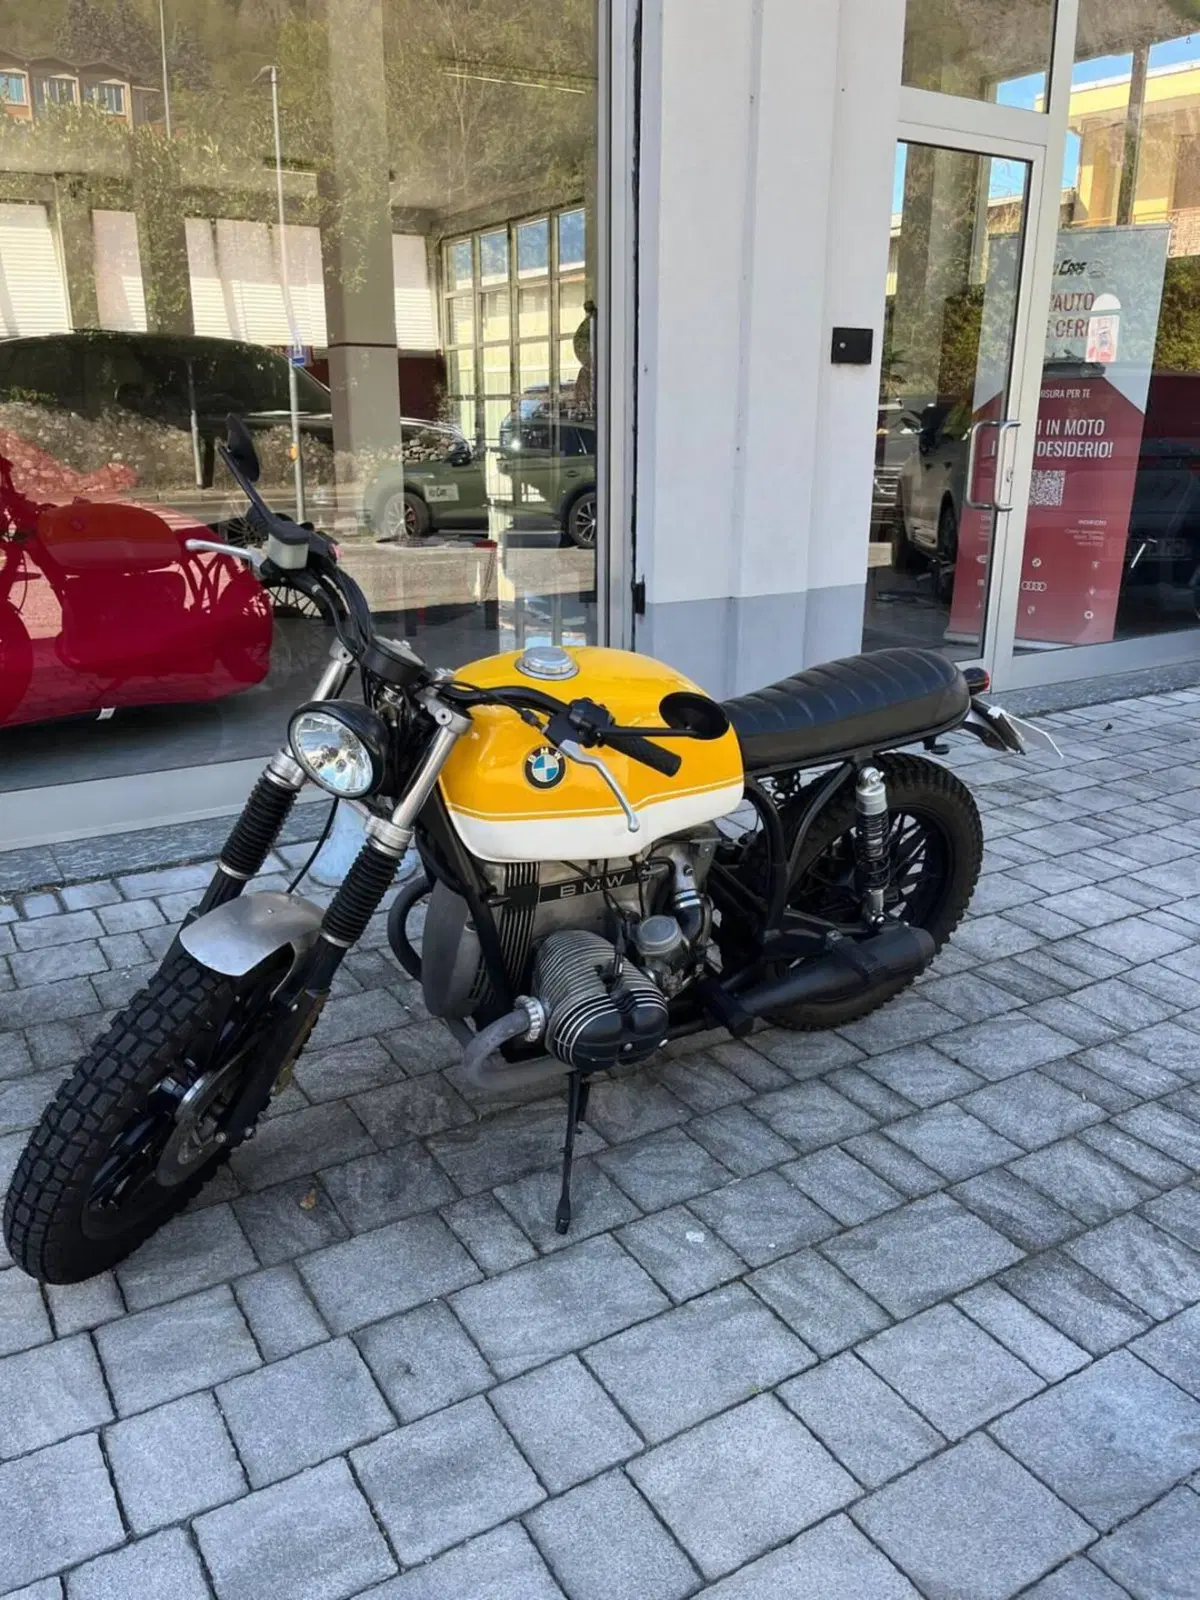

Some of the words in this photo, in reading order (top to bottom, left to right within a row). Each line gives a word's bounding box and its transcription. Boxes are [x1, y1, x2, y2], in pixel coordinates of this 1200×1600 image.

[1066, 389, 1081, 399] PER
[1083, 388, 1091, 399] TE
[1046, 419, 1060, 436] IN
[1064, 419, 1105, 436] MOTO
[1036, 441, 1114, 458] DESIDERIO!
[560, 874, 625, 897] BMW
